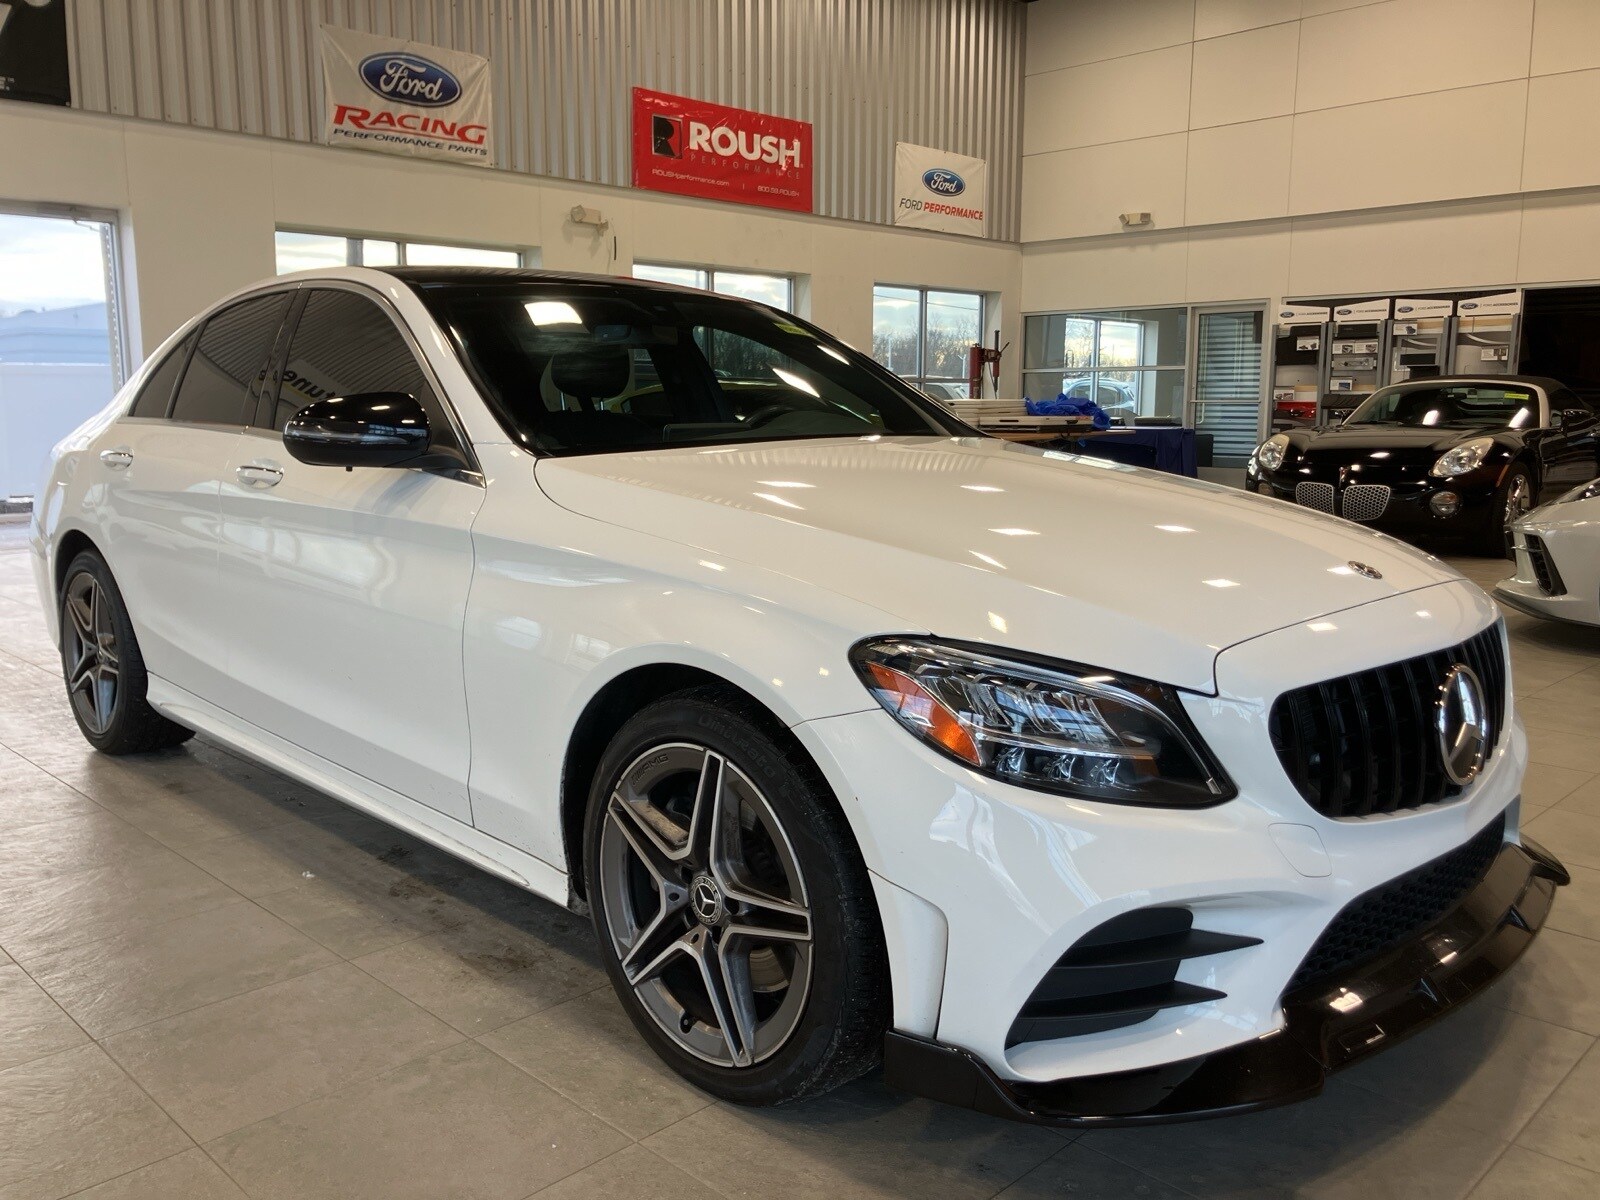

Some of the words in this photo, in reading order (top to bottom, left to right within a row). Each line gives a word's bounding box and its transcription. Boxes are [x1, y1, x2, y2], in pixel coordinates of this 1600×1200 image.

[380, 59, 443, 101] Ford
[333, 103, 488, 145] RACING
[333, 128, 444, 149] PERFORMANCE
[448, 144, 488, 157] PARTS
[689, 121, 801, 169] ROUSH
[690, 154, 800, 180] PERFORMANCE
[930, 172, 958, 193] Ford
[899, 198, 923, 211] FORD
[923, 202, 984, 221] PERFORMANCE
